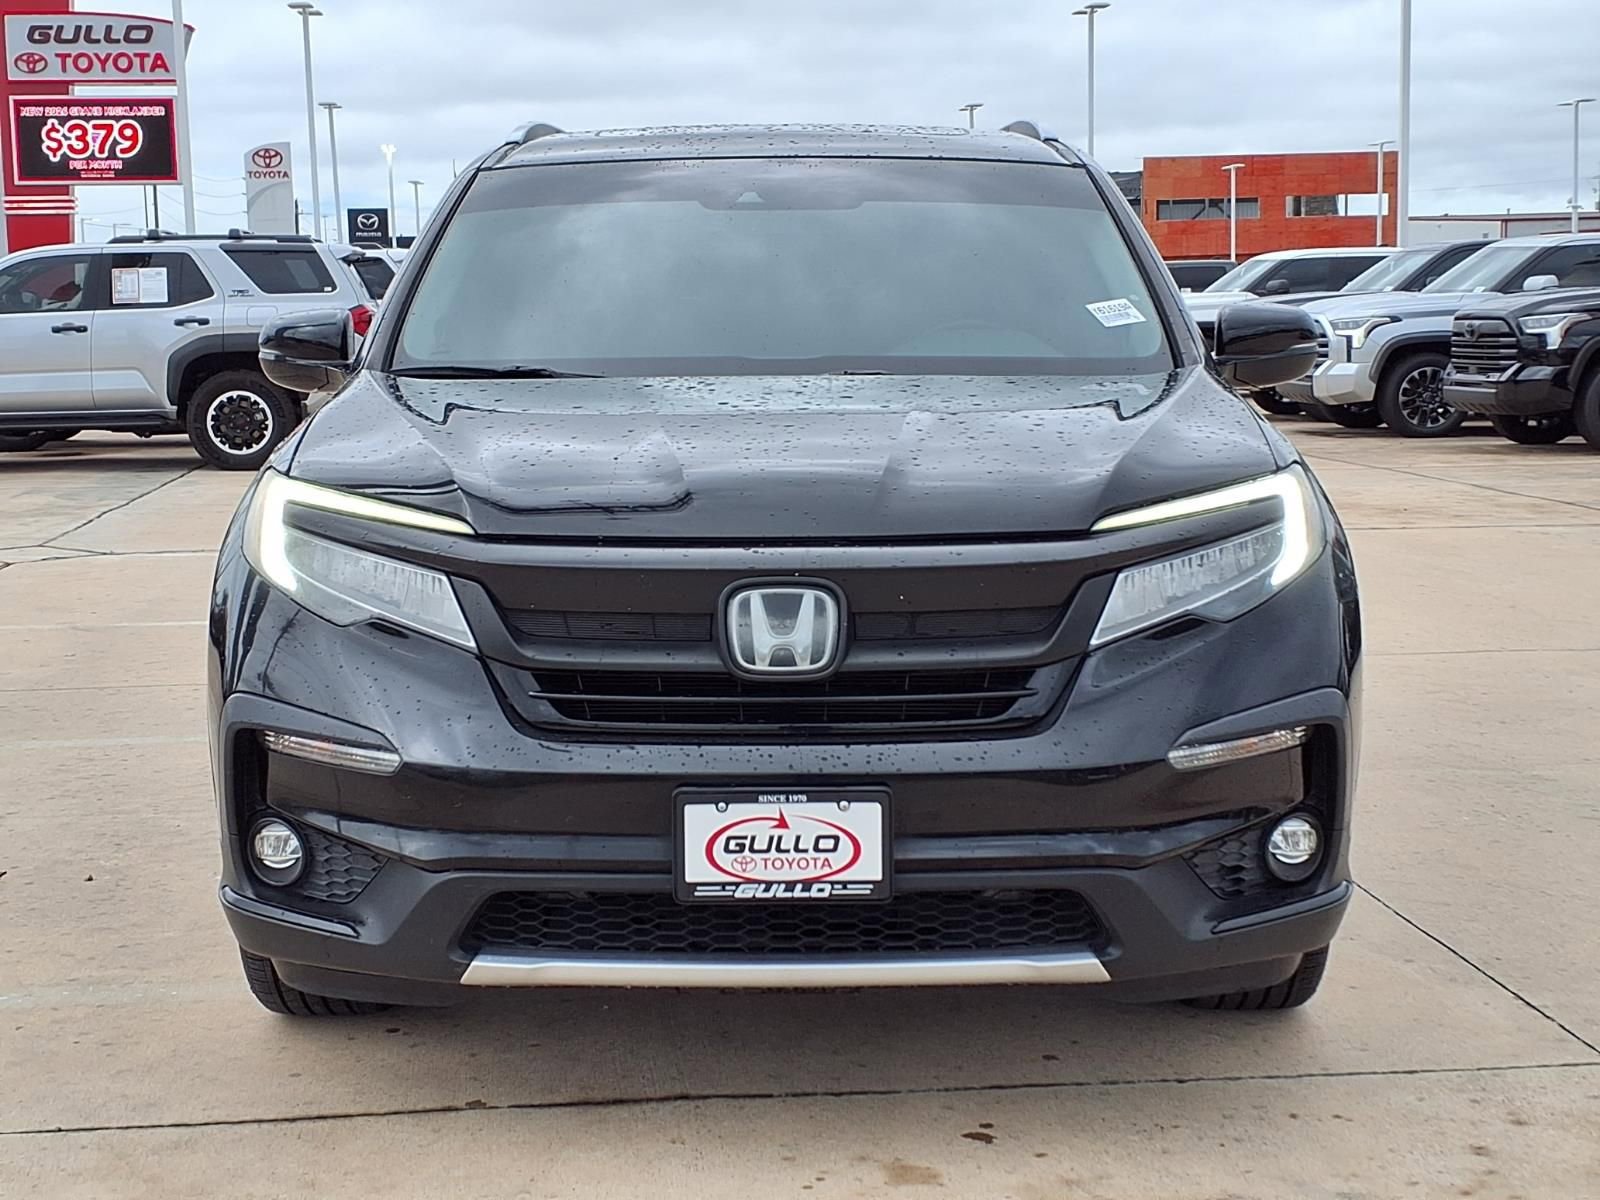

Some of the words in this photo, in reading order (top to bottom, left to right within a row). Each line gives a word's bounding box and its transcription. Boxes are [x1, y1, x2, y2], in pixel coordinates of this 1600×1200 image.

[27, 25, 153, 44] GULLO
[55, 52, 170, 73] TOYOTA
[20, 106, 43, 116] NEW
[104, 106, 165, 116] HIGHLANDER
[42, 119, 143, 162] $379
[69, 160, 88, 170] PER
[89, 160, 123, 170] MONTH
[248, 171, 289, 179] TOYOTA
[758, 794, 787, 803] SINCE
[788, 794, 807, 803] 1970
[723, 834, 840, 853] GULLO
[760, 857, 833, 871] TOYOTA
[734, 883, 832, 898] GULLO
